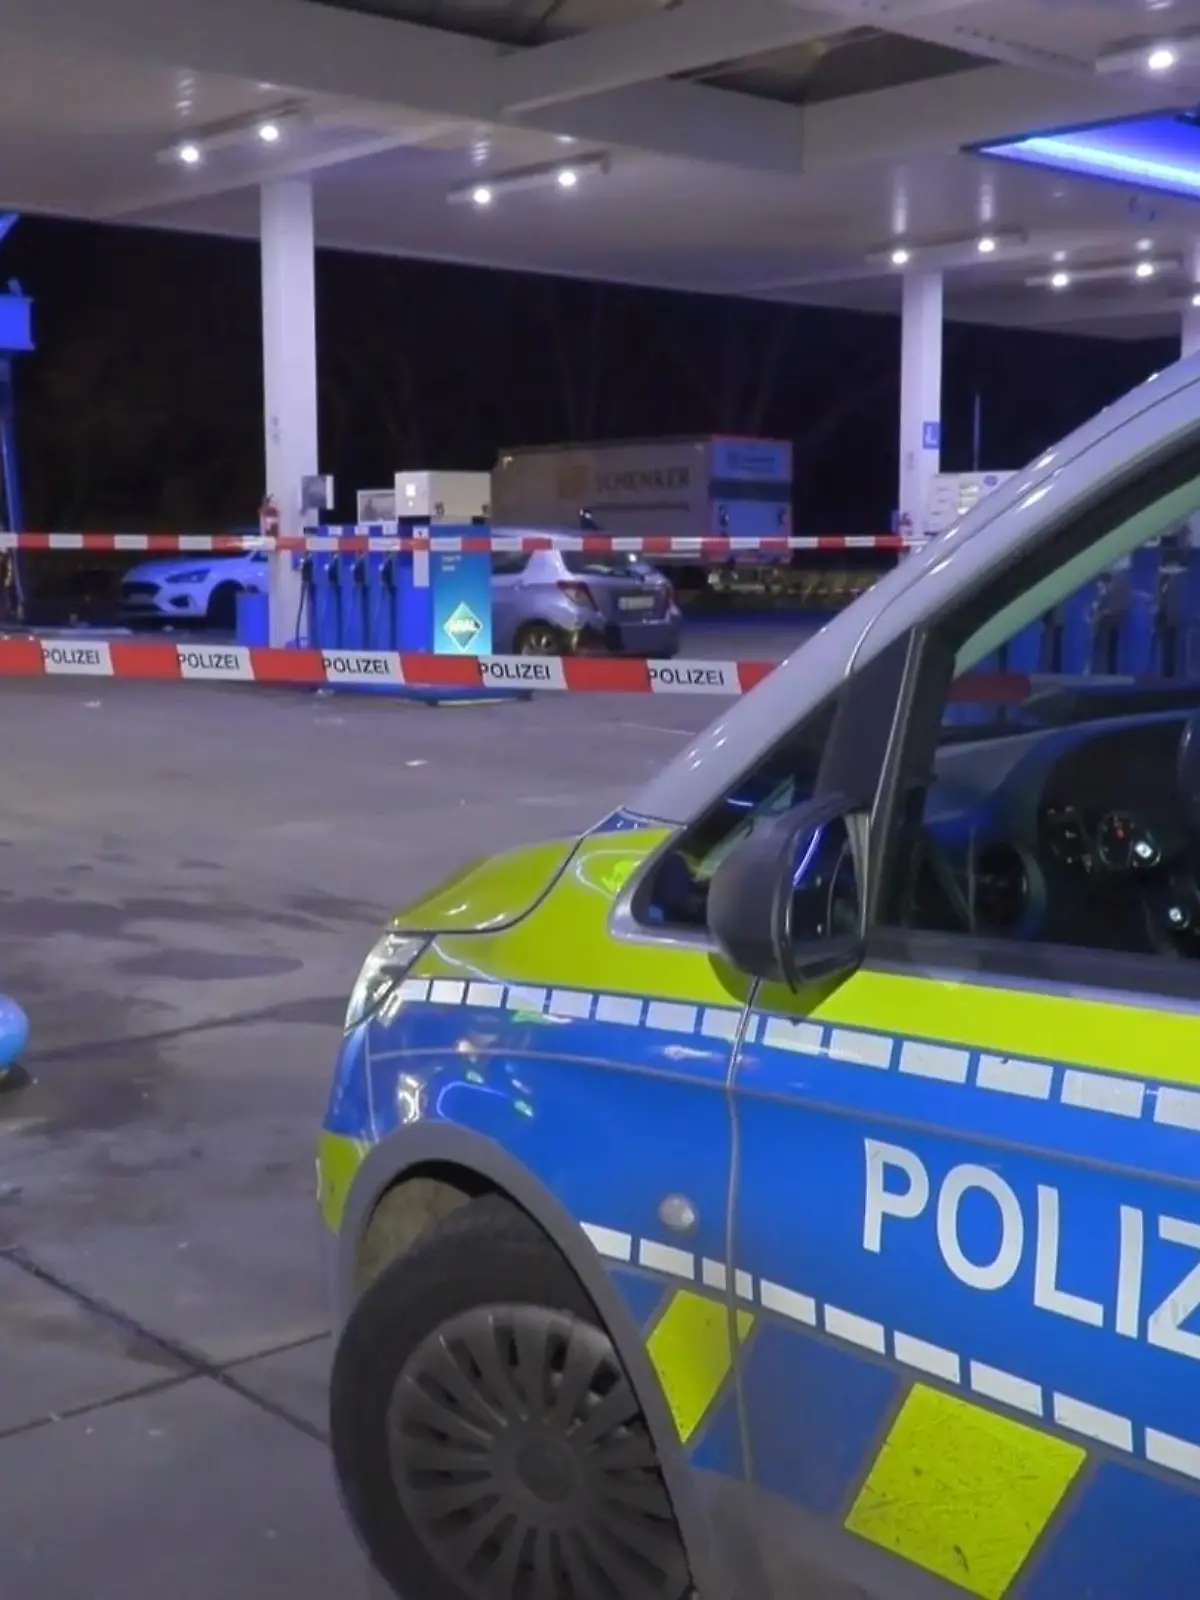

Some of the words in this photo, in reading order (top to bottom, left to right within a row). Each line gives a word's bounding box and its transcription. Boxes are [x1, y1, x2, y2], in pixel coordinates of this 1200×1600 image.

[43, 648, 101, 665] POLIZEI
[177, 653, 240, 670] POLIZEI
[322, 657, 390, 675] POLIZEI
[479, 662, 551, 680] POLIZEI
[648, 668, 724, 686] POLIZEI
